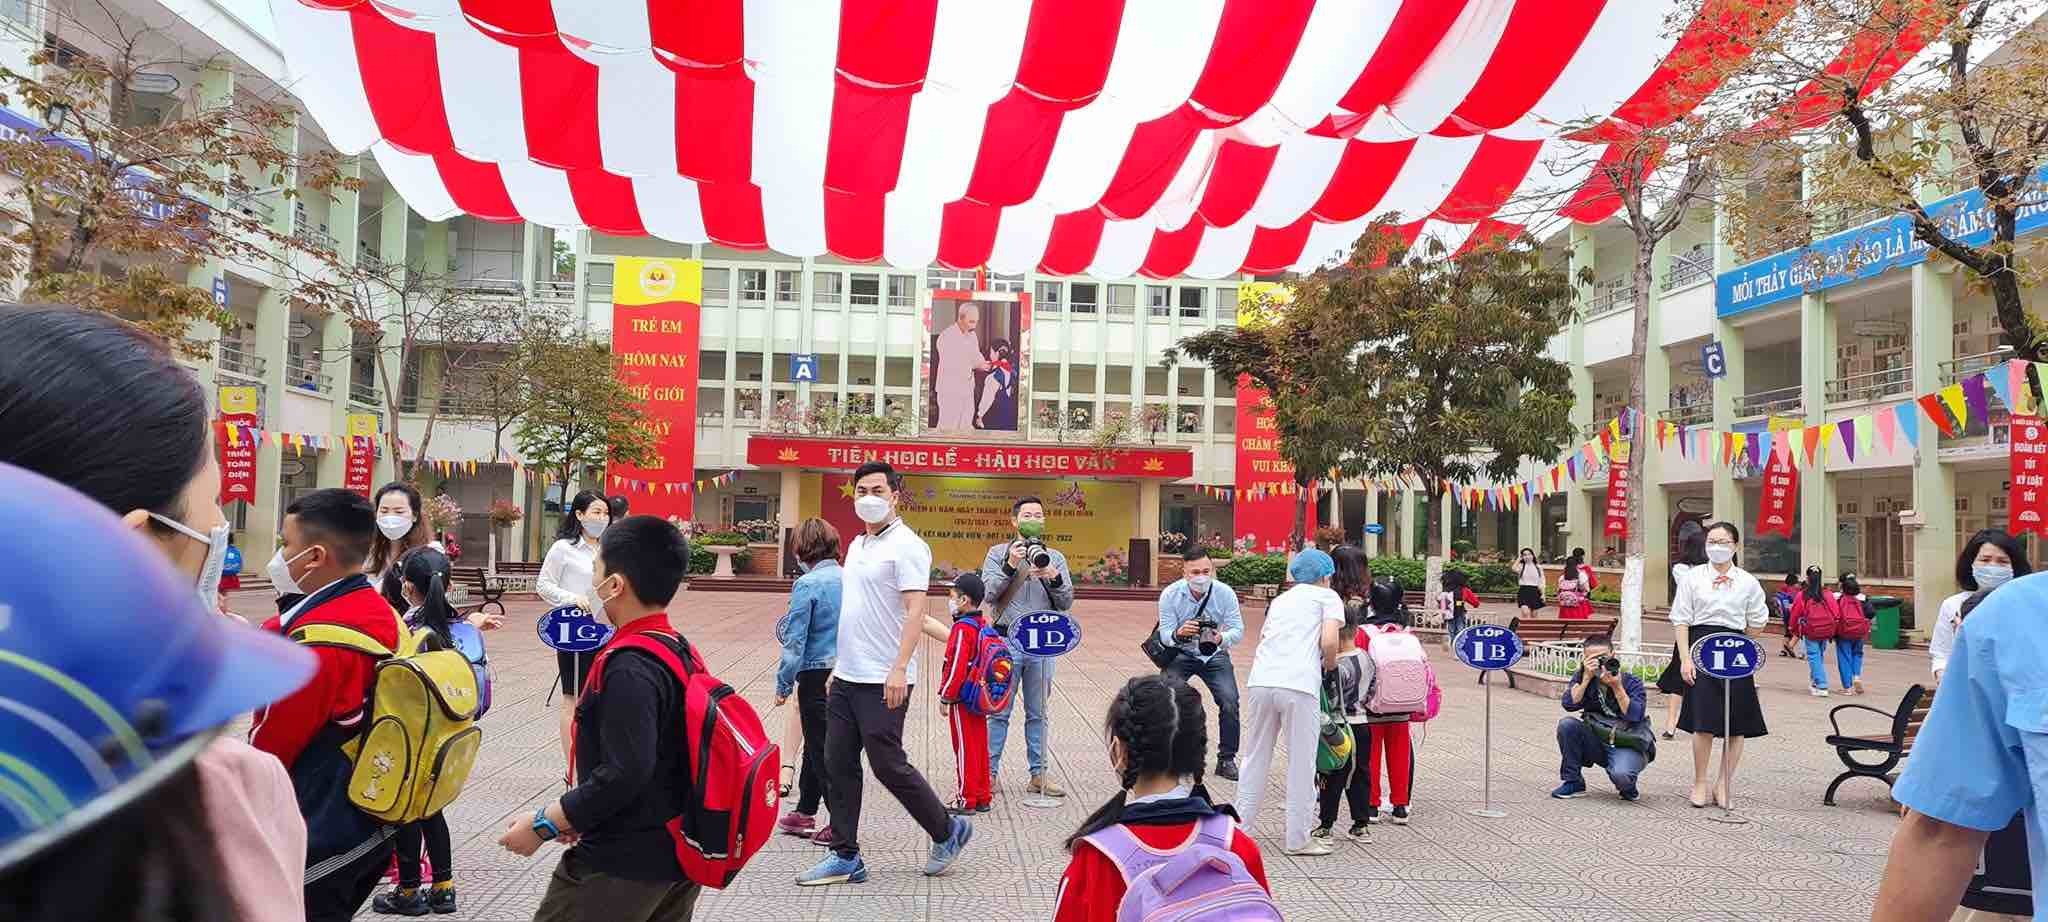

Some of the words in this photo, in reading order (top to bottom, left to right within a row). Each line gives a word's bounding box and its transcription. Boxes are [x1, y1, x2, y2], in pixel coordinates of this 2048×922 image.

[1885, 227, 1905, 258] LÀ
[661, 320, 682, 333] EM
[659, 354, 687, 368] NAY
[1708, 354, 1721, 374] C
[796, 363, 812, 378] A
[882, 450, 928, 470] HỌC
[974, 449, 1020, 471] HẬU
[1024, 455, 1069, 472] HỌC
[1252, 460, 1270, 472] VUI
